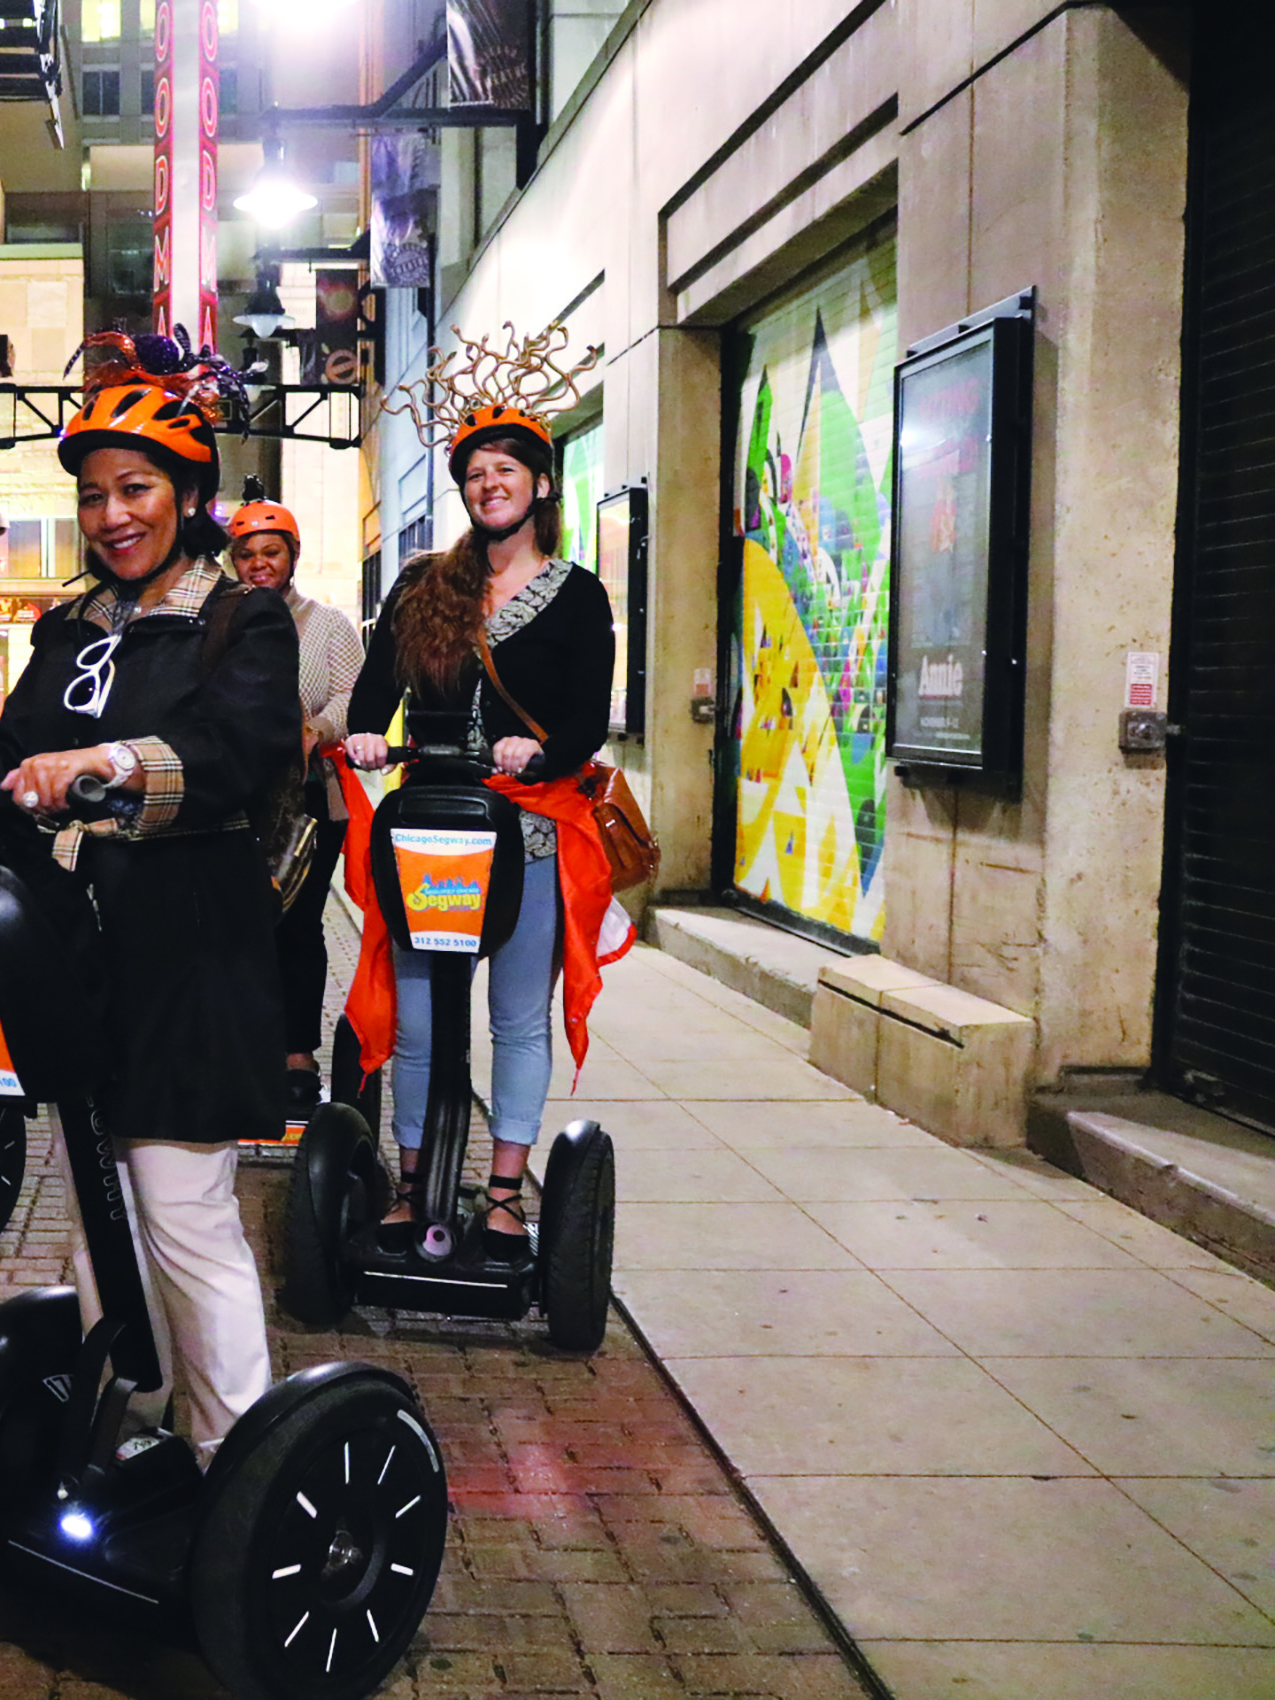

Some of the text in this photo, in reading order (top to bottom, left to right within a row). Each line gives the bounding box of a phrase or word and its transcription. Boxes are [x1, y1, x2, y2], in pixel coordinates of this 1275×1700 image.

[918, 653, 963, 697] Annie
[395, 833, 493, 846] ChicagoSegway.com
[406, 882, 482, 912] Segway
[414, 937, 477, 947] 312 552 5100
